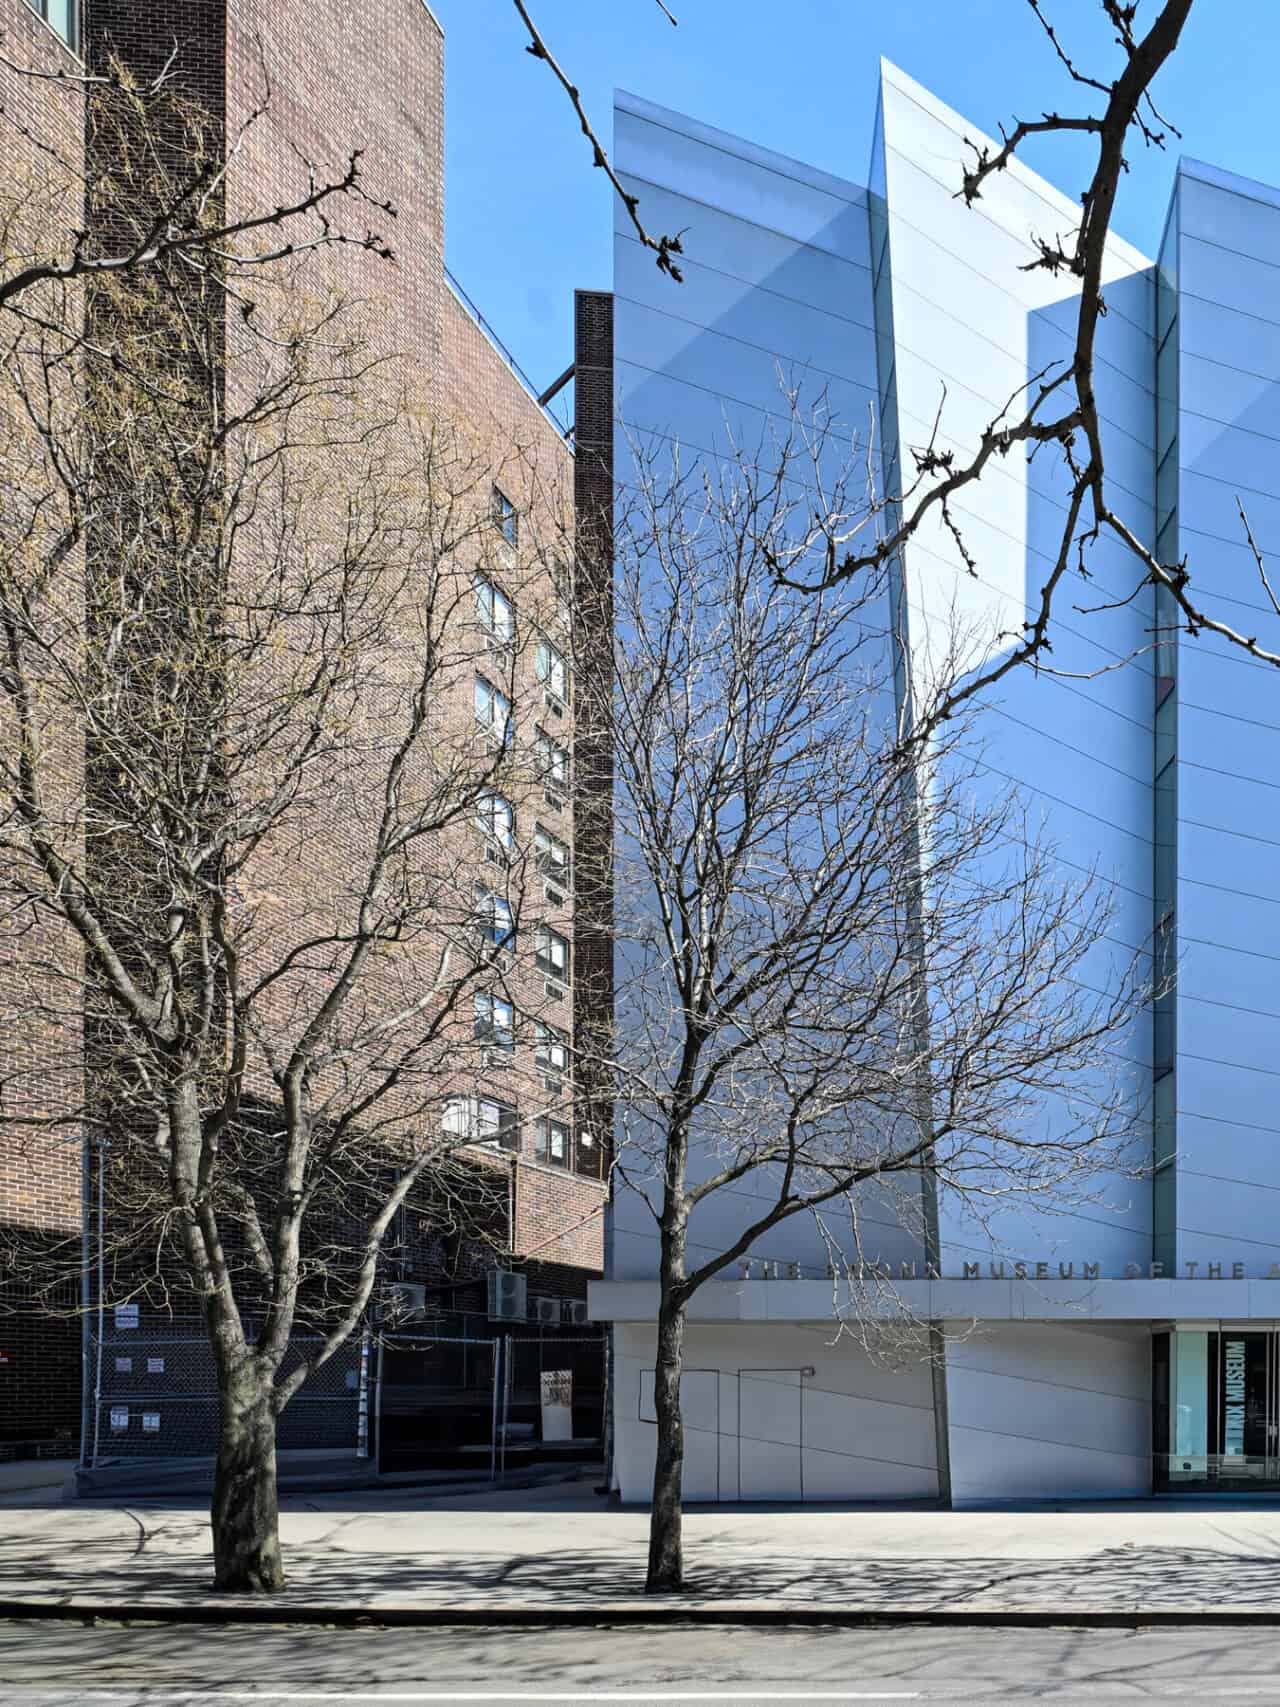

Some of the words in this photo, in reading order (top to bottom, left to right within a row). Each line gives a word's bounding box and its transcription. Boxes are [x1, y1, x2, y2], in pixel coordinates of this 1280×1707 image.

[738, 1262, 801, 1280] THE
[963, 1262, 1099, 1280] MUSEUM
[1122, 1262, 1164, 1280] OF
[1185, 1262, 1245, 1280] THE
[1225, 1341, 1246, 1402] MUSEUM
